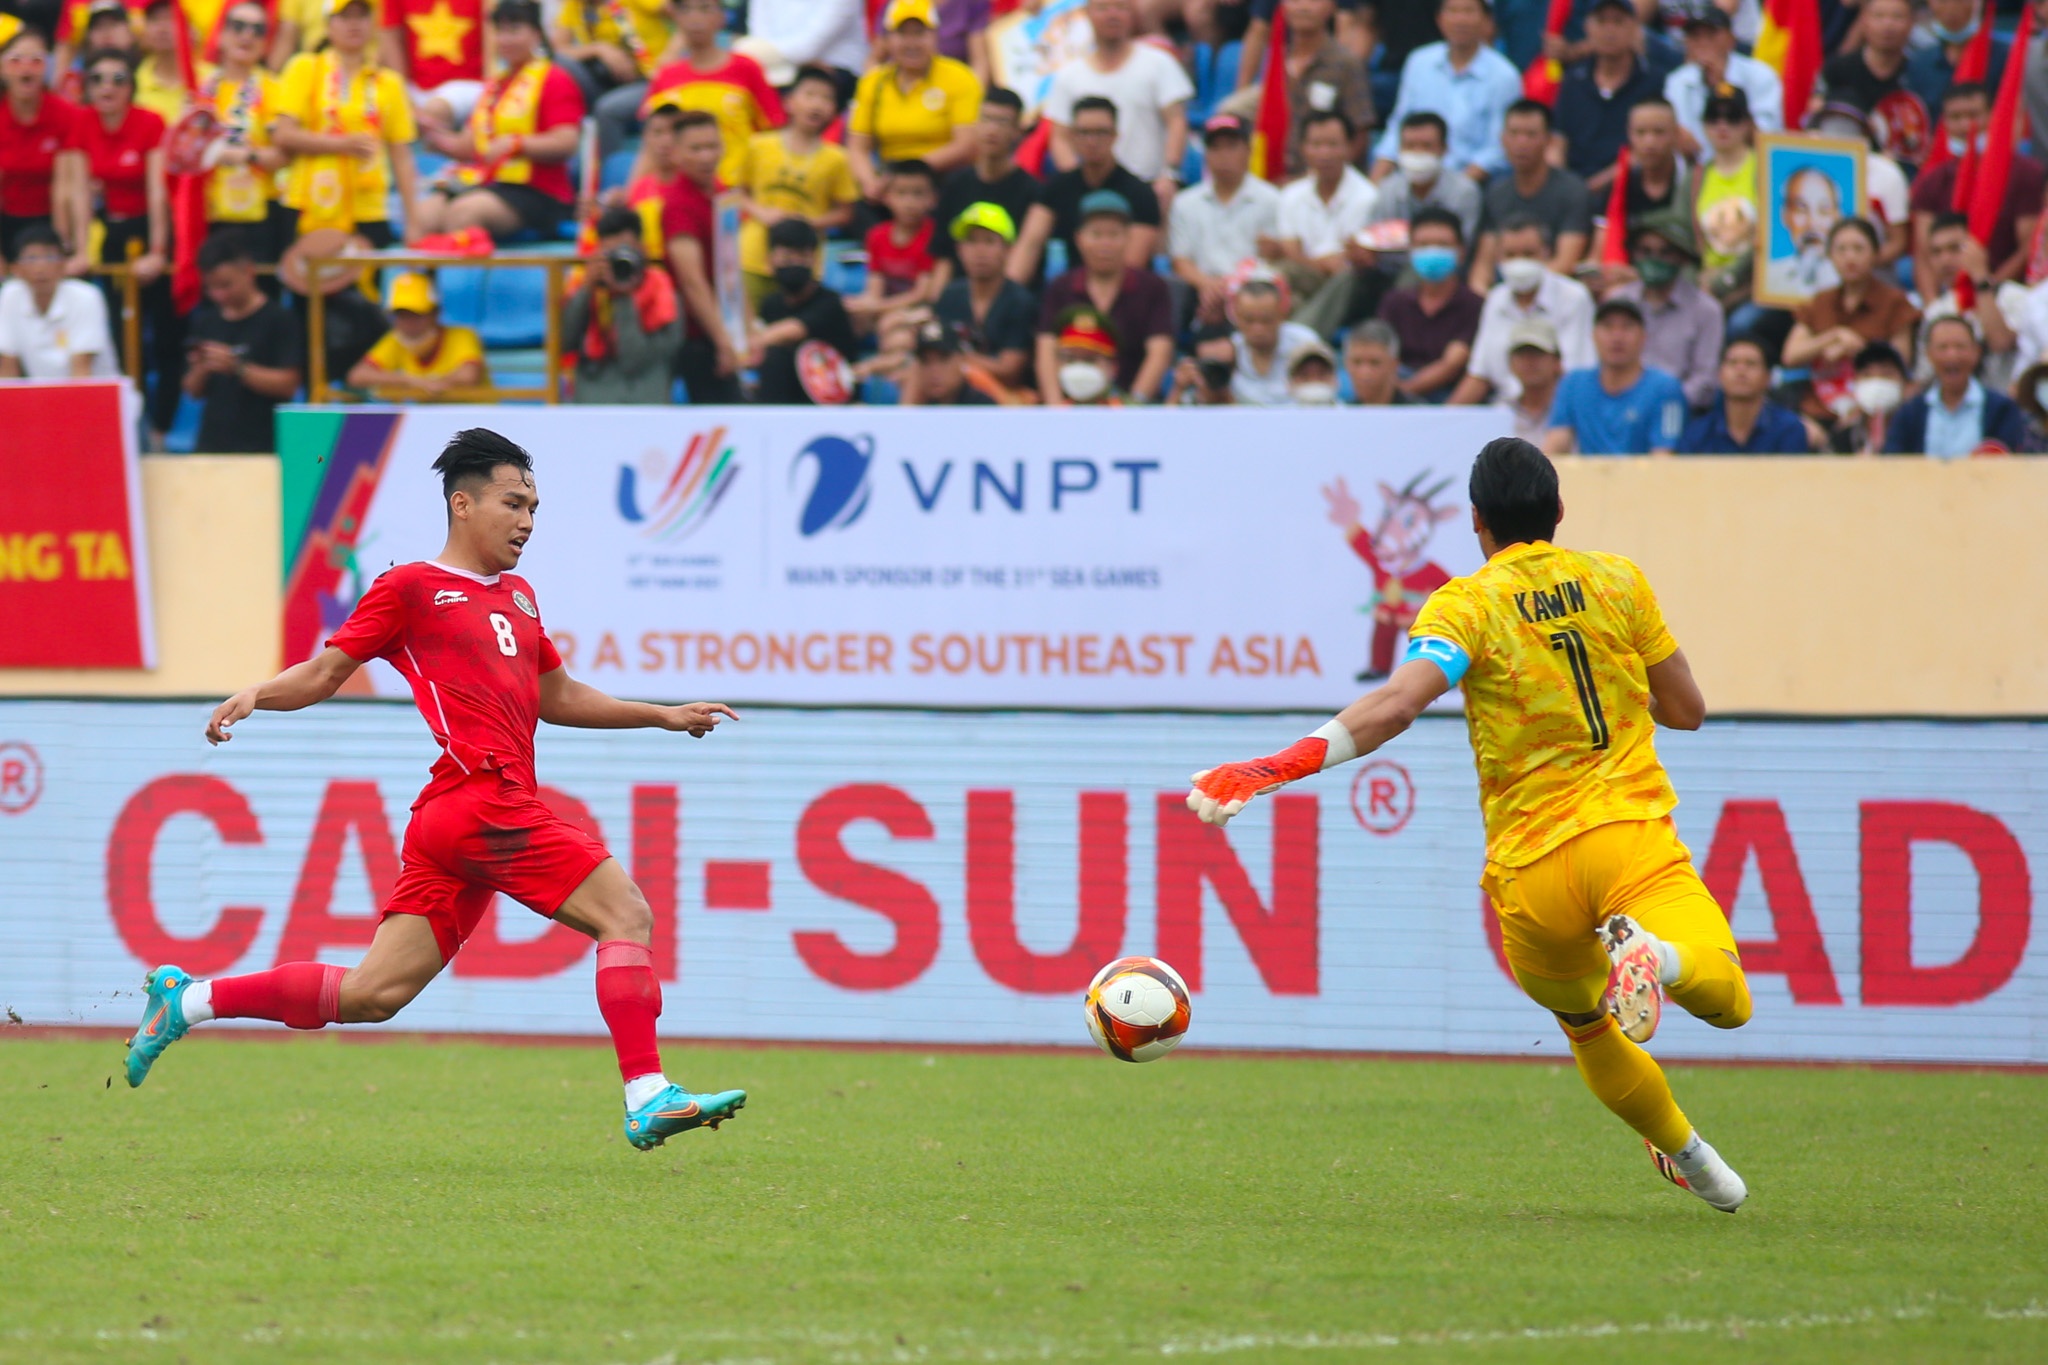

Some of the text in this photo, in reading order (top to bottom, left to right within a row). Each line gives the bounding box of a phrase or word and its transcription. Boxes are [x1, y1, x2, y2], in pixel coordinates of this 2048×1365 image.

[899, 459, 1162, 512] VNPT
[66, 530, 130, 580] TA
[786, 566, 837, 586] MAIN
[843, 566, 933, 587] SPONSOR
[941, 567, 965, 588] OF
[971, 567, 1006, 588] THE
[1051, 567, 1084, 588] SEA
[1092, 567, 1160, 588] GAMES
[1513, 580, 1587, 624] KAWIN
[488, 612, 518, 657] 8
[592, 631, 626, 672] A
[639, 631, 895, 674] STRONGER
[909, 633, 1195, 676] SOUTHEAST
[1208, 633, 1323, 677] ASIA
[1549, 629, 1609, 751] 1
[1480, 798, 2033, 1006] AD
